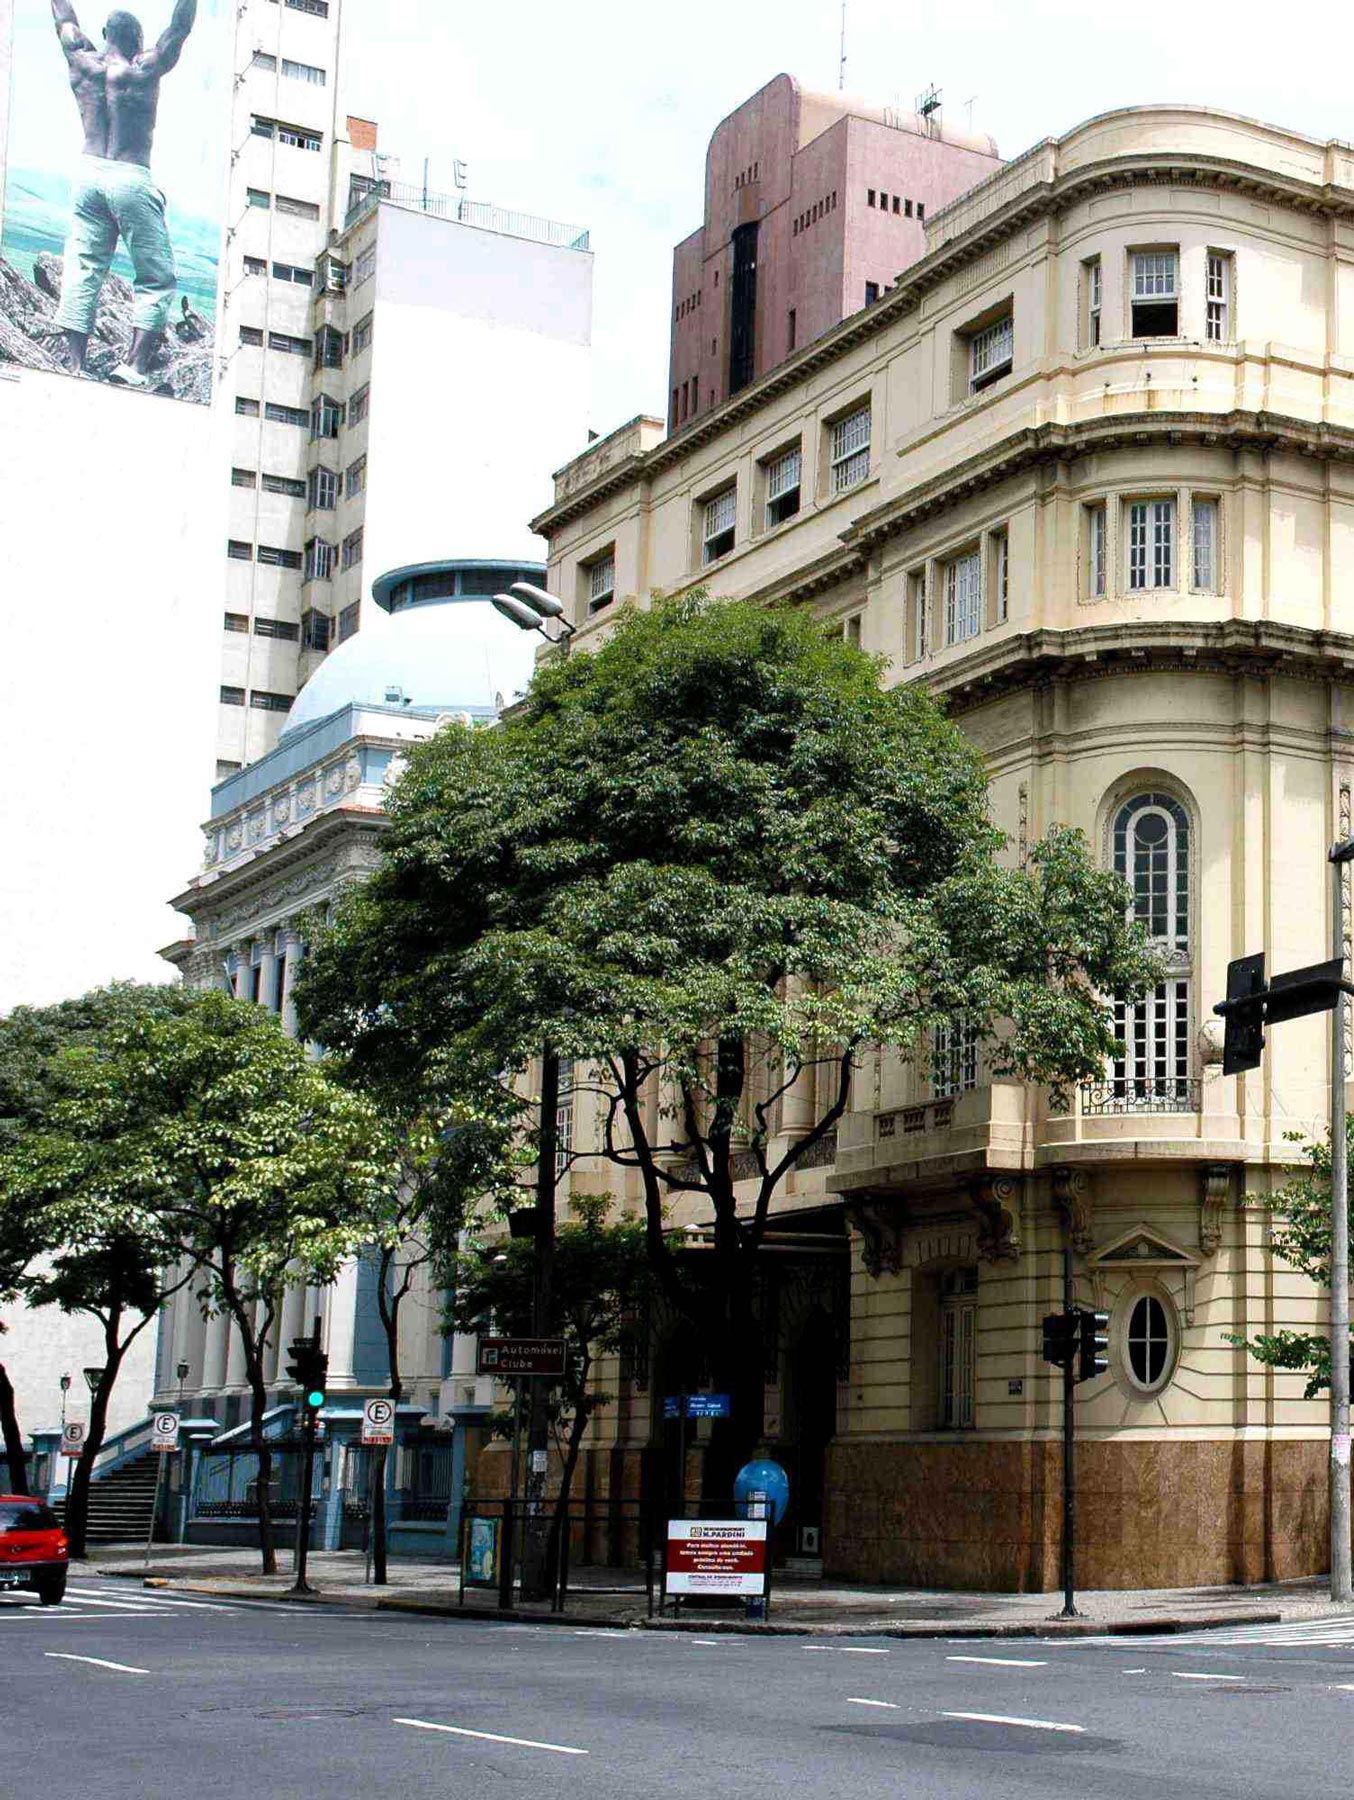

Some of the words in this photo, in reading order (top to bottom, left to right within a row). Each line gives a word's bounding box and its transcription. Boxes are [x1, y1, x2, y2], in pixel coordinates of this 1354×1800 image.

[501, 1343, 562, 1355] Automóvel
[501, 1359, 534, 1369] Clube
[374, 1405, 385, 1420] E
[162, 1417, 171, 1430] E
[70, 1426, 77, 1438] E
